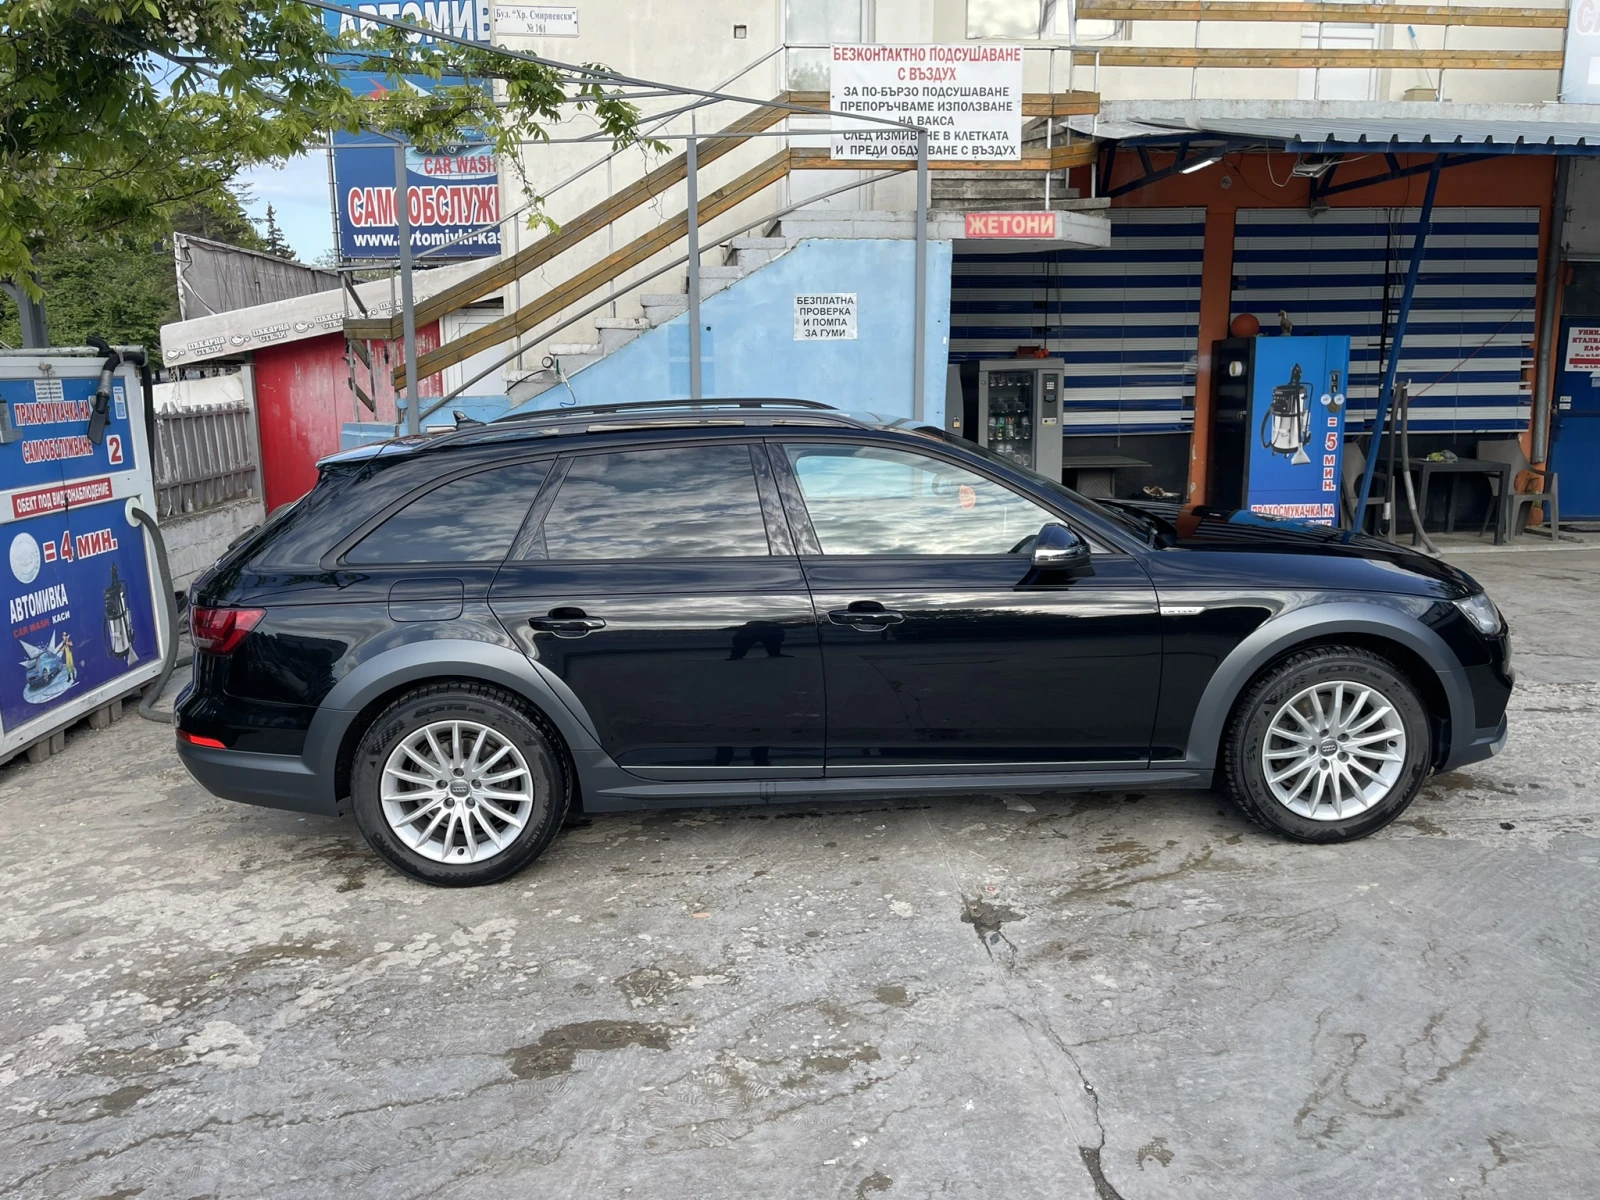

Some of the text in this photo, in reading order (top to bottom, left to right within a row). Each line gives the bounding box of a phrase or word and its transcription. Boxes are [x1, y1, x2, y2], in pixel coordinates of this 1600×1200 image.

[496, 9, 511, 20] Бул.
[535, 24, 546, 33] 161
[833, 47, 1021, 64] БЕЗКОНТАКТНО ПОДСУШАВАНЕ
[897, 67, 957, 83] С ВЪЗДУХ
[843, 87, 1010, 98] ЗА ПО-БЪРЗО ПОДСУШАВАНЕ
[840, 101, 1013, 112] ПРЕПОРЪЧВАМЕ ИЗПОЛЗВАНЕ
[898, 116, 955, 126] НА ВАКСА
[843, 131, 1009, 142] СЛЕД ИЗМИВНЕ В КЛЕТКАТА
[835, 146, 1016, 157] И ПРЕДИ ОБДУВАНЕ С ВЪЗДУХ
[424, 155, 497, 175] CAR WASH
[968, 215, 1054, 235] ЖЕТОНИ
[796, 297, 854, 305] БЕЗПЛАТНА
[803, 318, 848, 326] И ПОМПА
[252, 323, 290, 337] ПЕКАРНА
[804, 329, 846, 337] ЗА ГУМИ
[187, 336, 226, 350] ПЕКАРНА
[14, 401, 79, 426] ПРАХОСМУКАЧКА
[78, 400, 91, 421] НА
[1325, 432, 1338, 451] 5
[22, 435, 93, 464] САМООБСЛУЖВАНЕ
[108, 436, 122, 463] 2
[16, 495, 37, 513] ОБЕКТ
[38, 493, 53, 509] ПОД
[1322, 504, 1335, 517] НА
[61, 530, 74, 563] 4
[10, 583, 69, 624] АВТОМИВКА
[52, 610, 71, 624] КАСИ
[14, 618, 50, 638] CAR WASH
